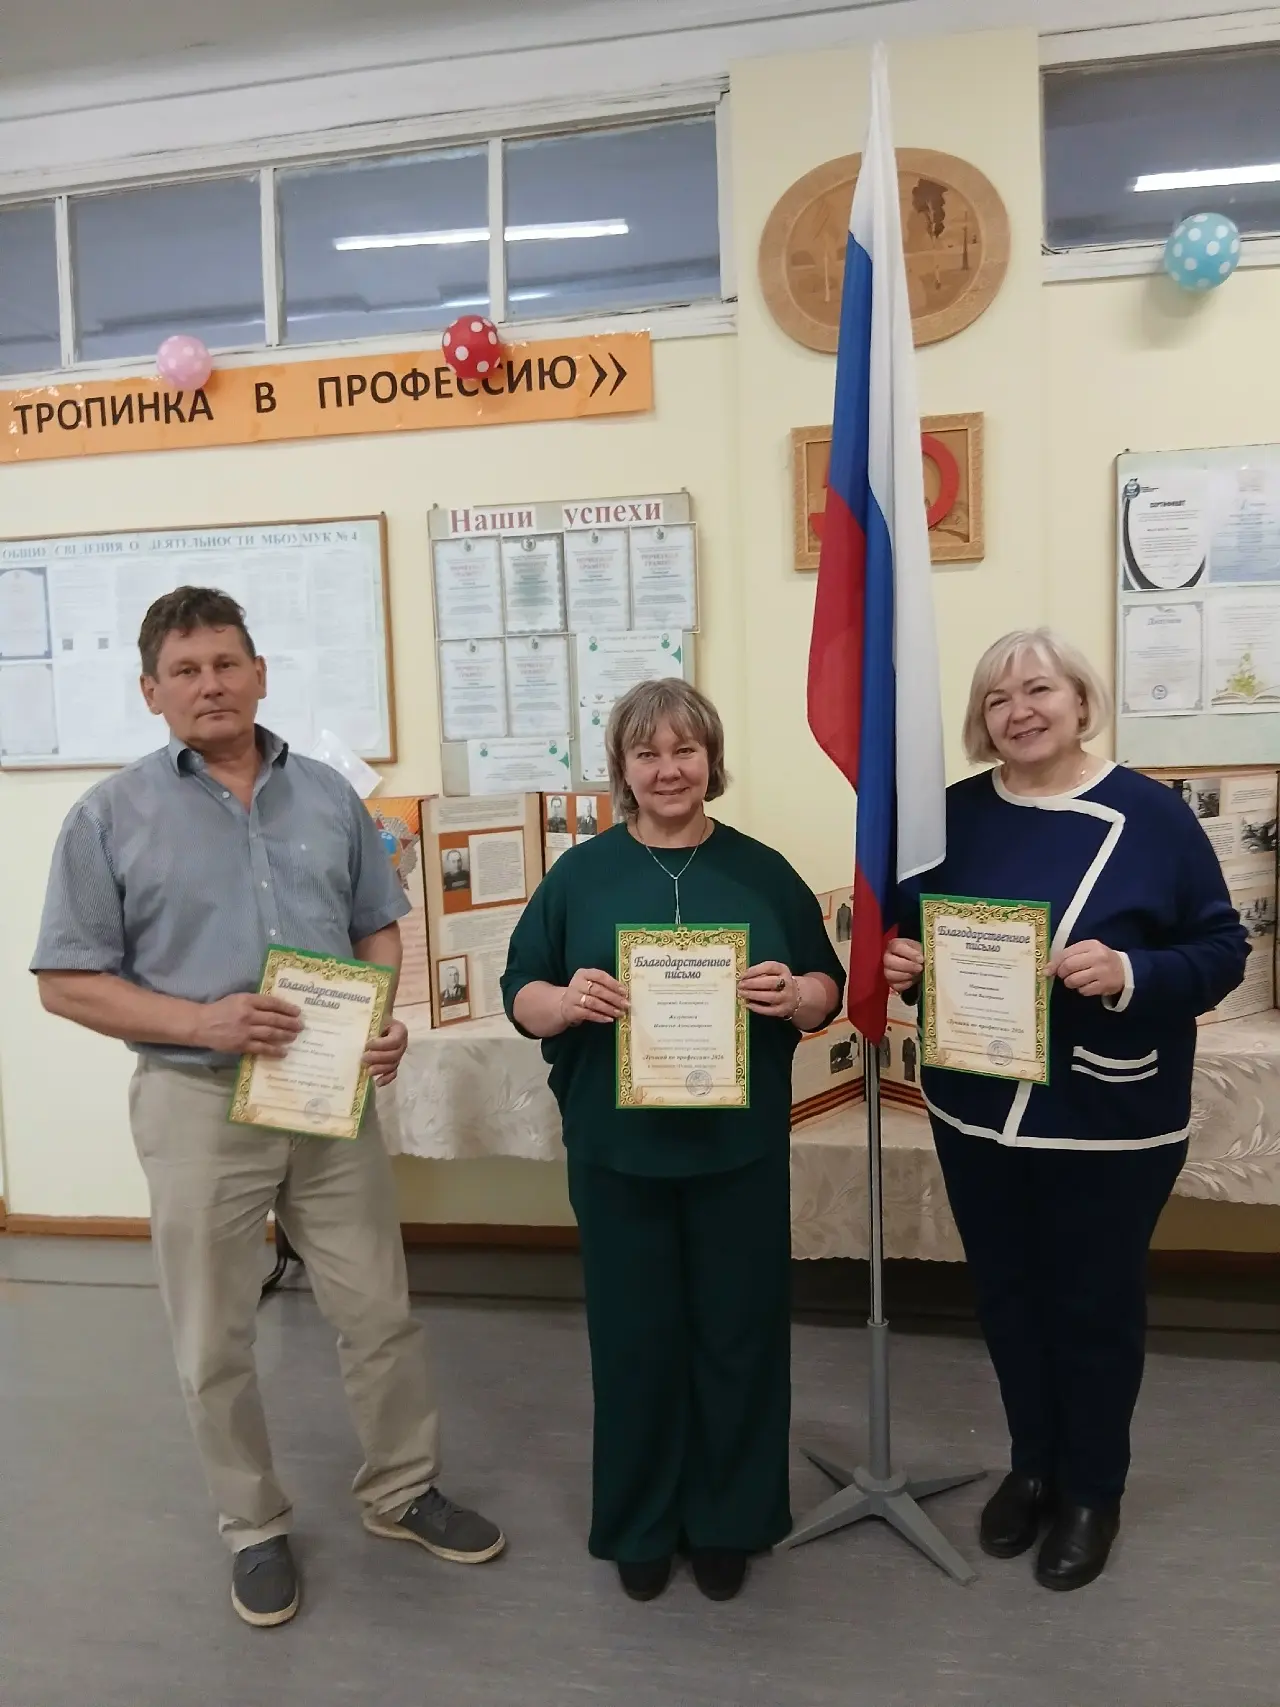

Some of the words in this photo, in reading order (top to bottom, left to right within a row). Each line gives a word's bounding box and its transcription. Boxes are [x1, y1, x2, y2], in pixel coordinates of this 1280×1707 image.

[13, 388, 214, 435] ТРОПИНКА
[255, 382, 277, 414] В
[450, 509, 533, 533] Наши
[563, 502, 662, 528] успехи
[129, 540, 140, 550] О
[937, 925, 1031, 943] Благодарственное
[965, 942, 1001, 952] письмо
[633, 954, 731, 970] Благодарственное
[664, 970, 702, 979] письмо
[278, 977, 371, 1004] Благодарственное
[304, 996, 341, 1010] письмо
